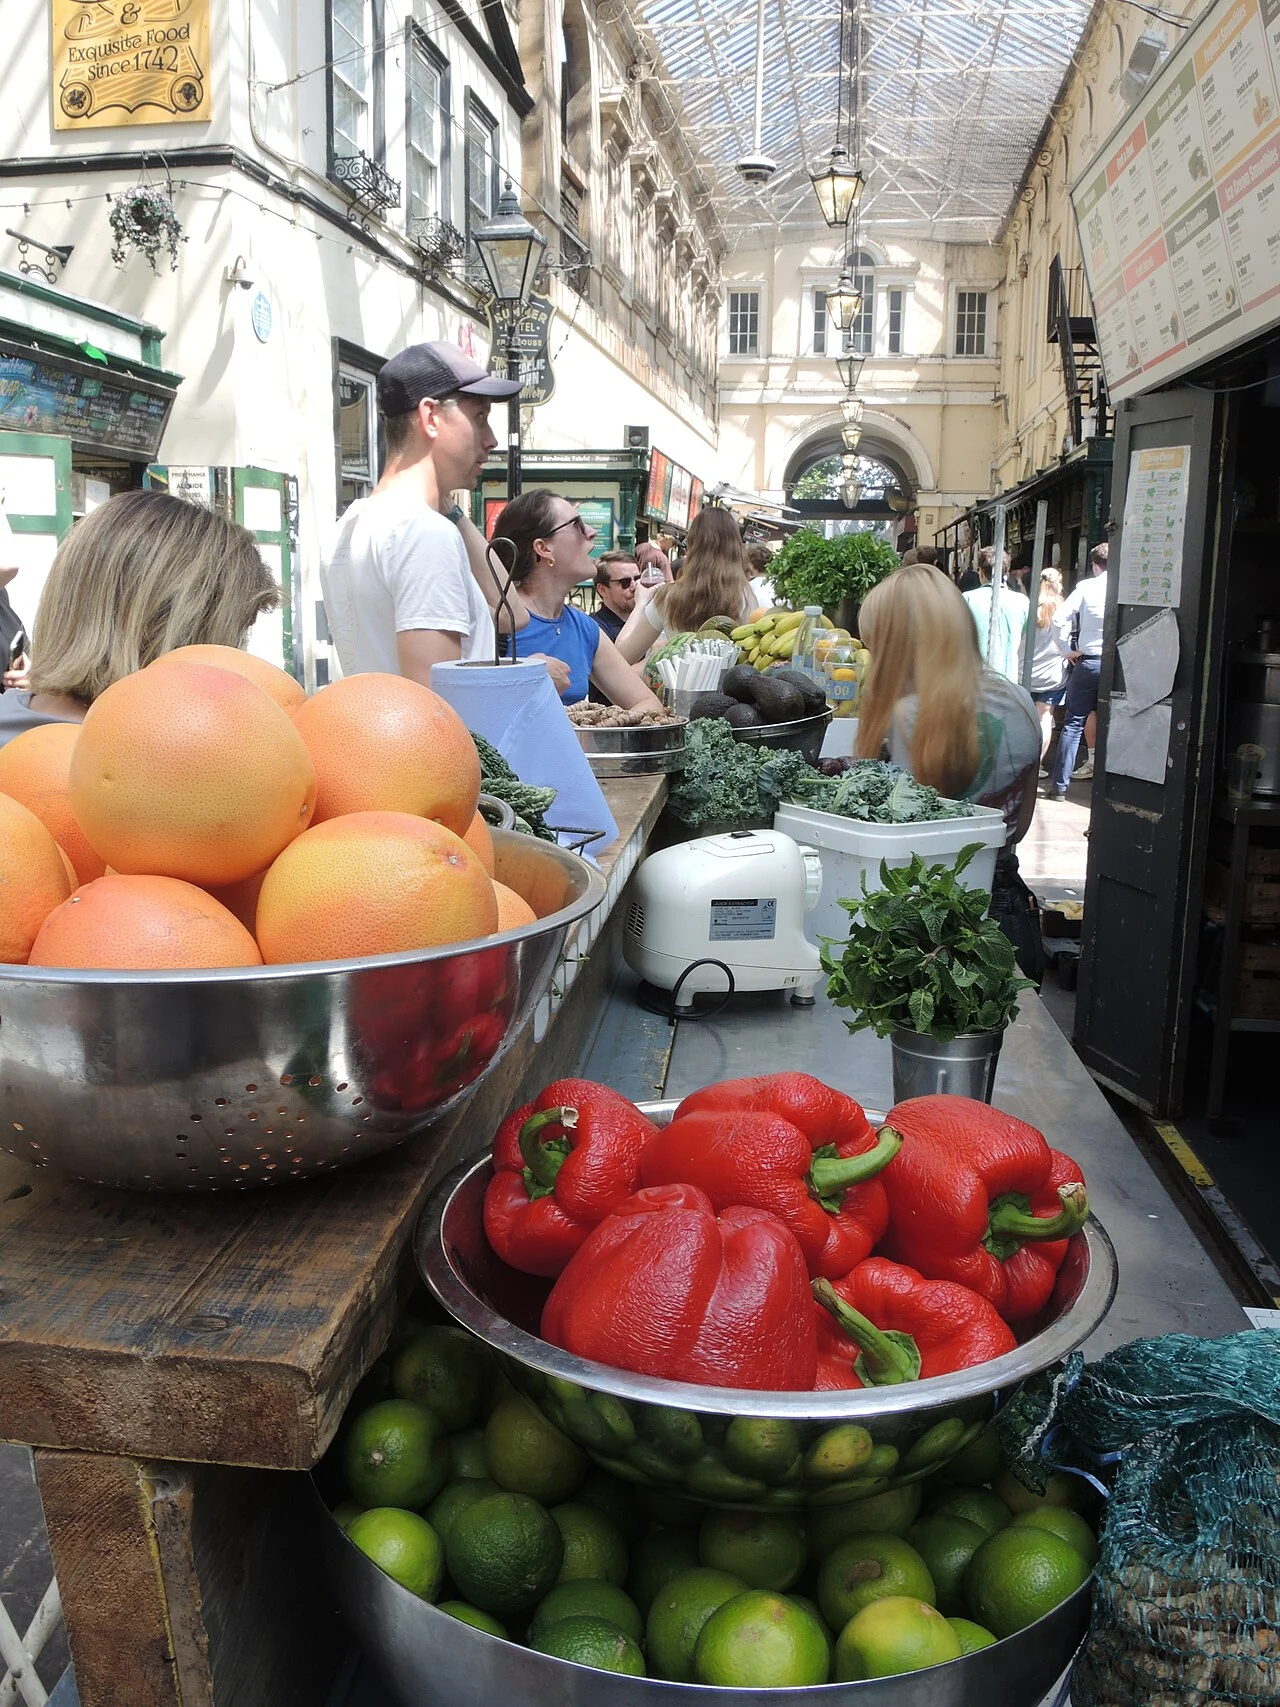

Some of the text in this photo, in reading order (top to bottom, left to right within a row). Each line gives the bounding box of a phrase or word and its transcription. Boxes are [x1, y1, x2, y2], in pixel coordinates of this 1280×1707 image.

[120, 3, 141, 25] &
[68, 23, 190, 63] Exquisite Food
[87, 45, 179, 81] Since 1742
[1224, 147, 1279, 203] Ice Cream Smoothies
[1185, 207, 1209, 236] Smoothies
[504, 322, 535, 332] TEL
